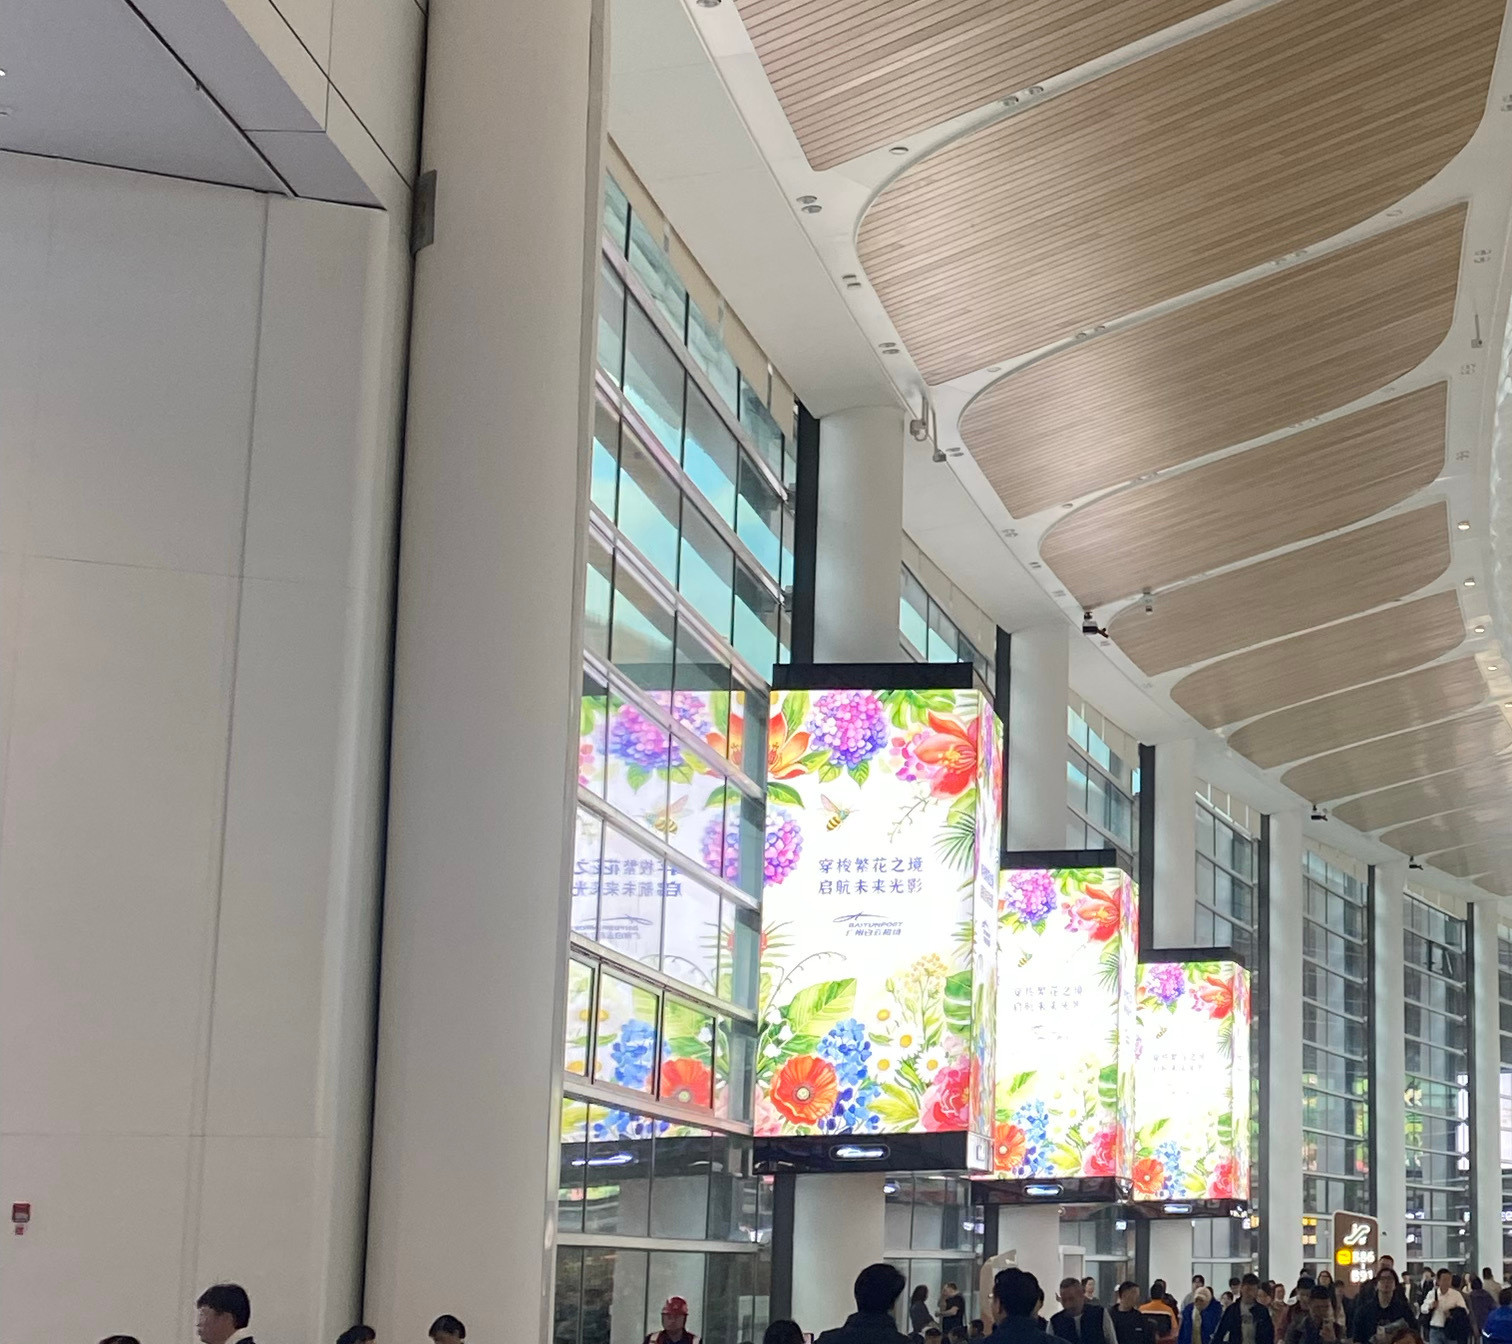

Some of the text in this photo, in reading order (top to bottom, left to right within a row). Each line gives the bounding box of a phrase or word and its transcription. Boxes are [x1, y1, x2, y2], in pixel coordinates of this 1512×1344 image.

[818, 856, 923, 874] 穿梭繁花之境
[818, 878, 923, 895] 启航未来光影
